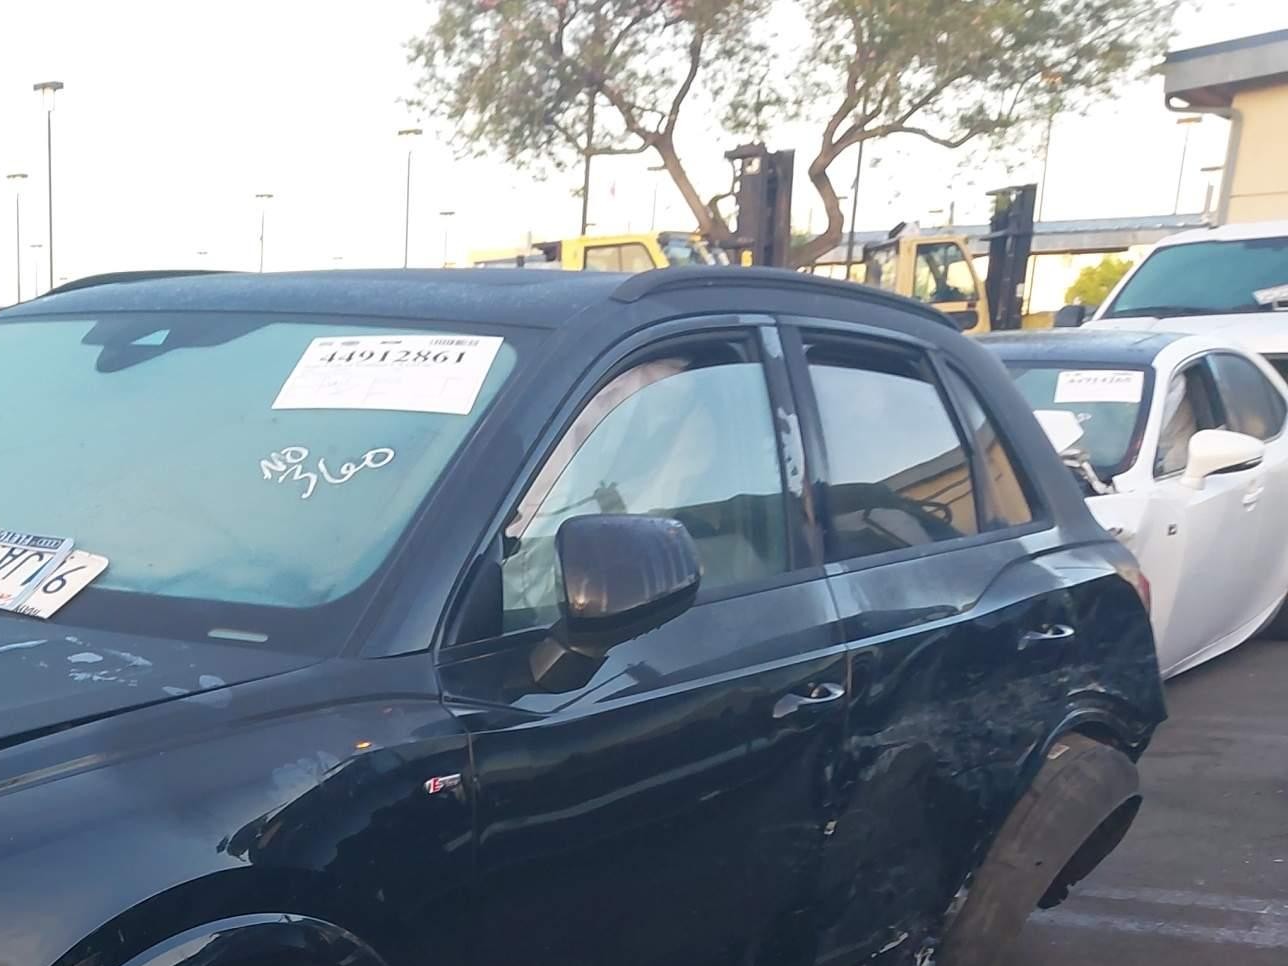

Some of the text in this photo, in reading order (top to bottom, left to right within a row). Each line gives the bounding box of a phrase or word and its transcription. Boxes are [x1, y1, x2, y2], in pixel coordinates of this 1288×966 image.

[319, 350, 466, 364] 44912861
[260, 446, 309, 480] NO
[278, 447, 395, 499] 360
